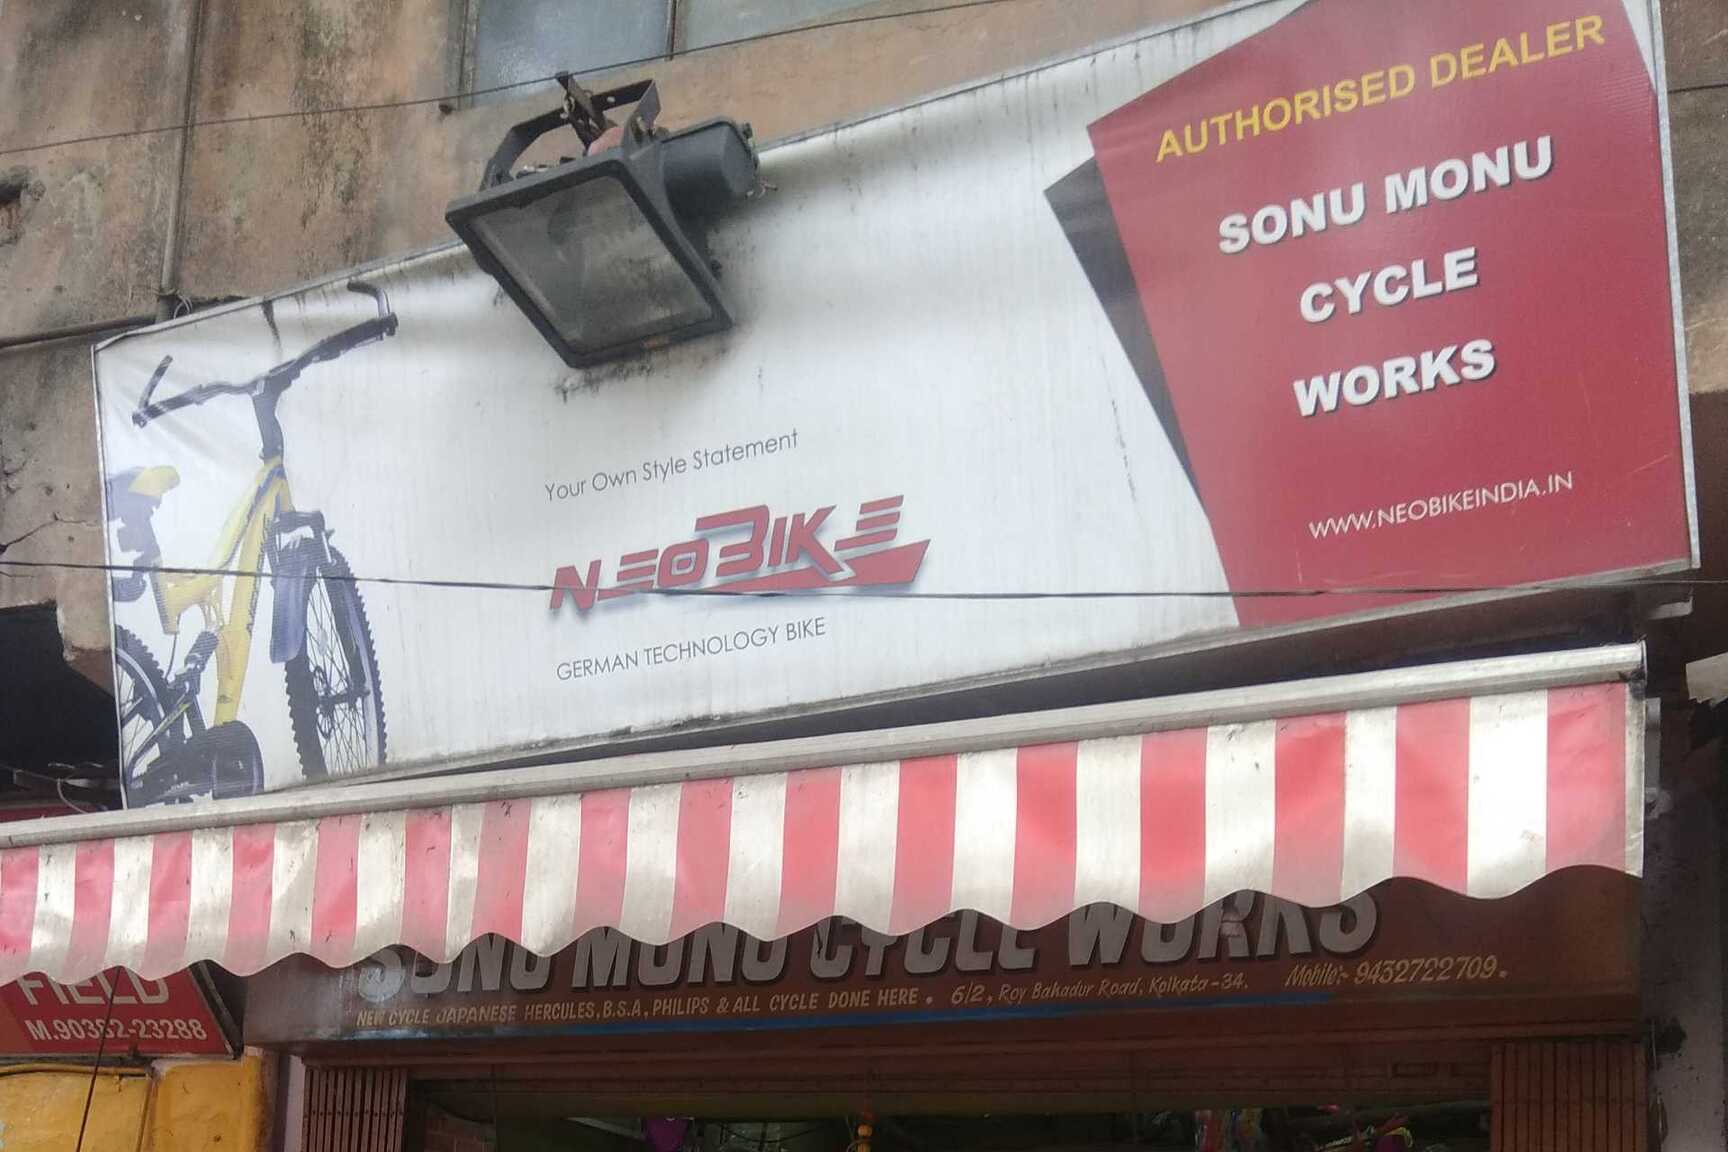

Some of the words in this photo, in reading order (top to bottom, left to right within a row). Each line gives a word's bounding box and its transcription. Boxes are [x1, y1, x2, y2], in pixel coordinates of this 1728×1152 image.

[1156, 64, 1416, 162] AUTHORISED
[1430, 15, 1605, 87] DEALER
[1218, 184, 1366, 255] SONU
[1385, 136, 1553, 213] MONU
[1299, 247, 1479, 323] CYCLE
[1293, 340, 1496, 417] WORKS
[545, 478, 587, 502] Your
[593, 469, 637, 492] Own
[643, 454, 688, 486] Style
[693, 428, 799, 470] Statement
[1309, 471, 1574, 540] WWW.NEOBIKEINDIA.IN
[549, 495, 922, 610] NEOBIKE
[556, 651, 639, 682] GERMAN
[644, 627, 779, 666] TECHNOLOGY
[786, 616, 827, 642] BIKE
[356, 1009, 386, 1027] NEW
[389, 1008, 430, 1026] CYCLE
[436, 1004, 517, 1024] JAPANESE
[652, 996, 711, 1017] PHILIPS
[716, 997, 730, 1014] &
[732, 995, 760, 1014] ALL
[769, 992, 819, 1011] CYCLE
[828, 989, 871, 1009] DONE
[877, 987, 920, 1006] HERE
[999, 983, 1028, 1008] Roy
[1031, 978, 1094, 1000] Bahadur
